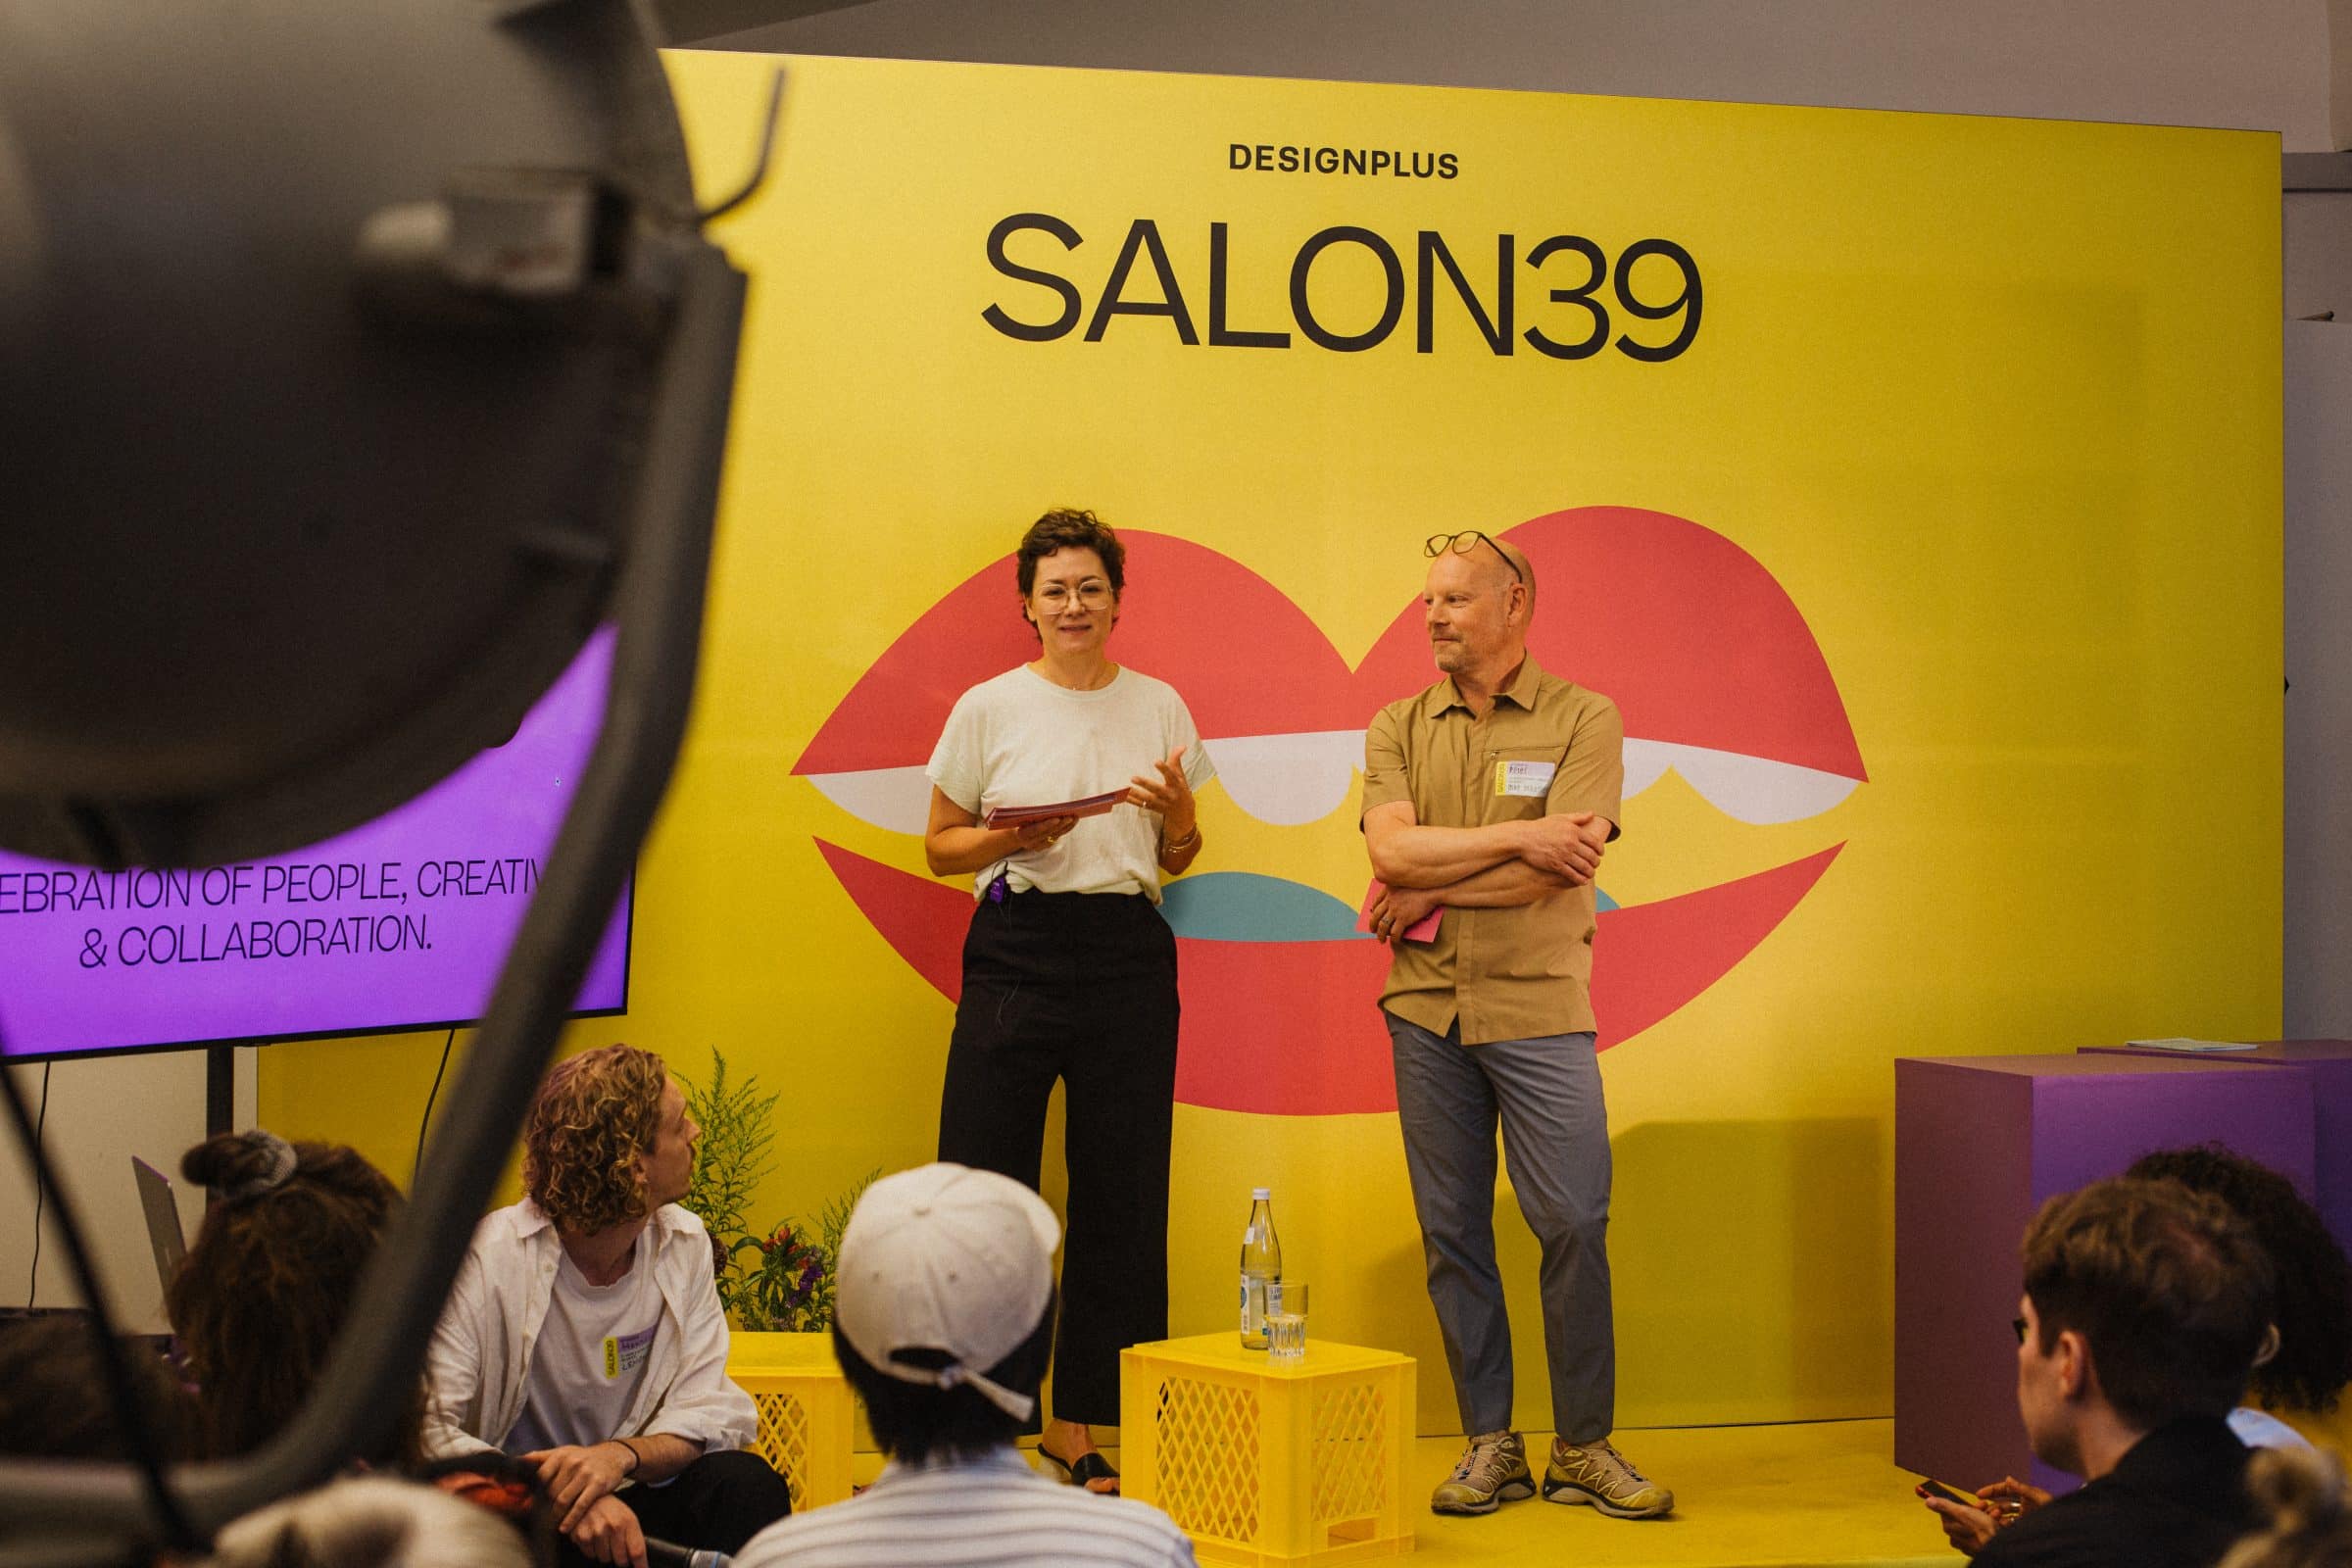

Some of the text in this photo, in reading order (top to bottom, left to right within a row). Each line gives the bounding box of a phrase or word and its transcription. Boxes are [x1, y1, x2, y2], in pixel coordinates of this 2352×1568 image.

[1228, 142, 1459, 180] DESIGNPLUS
[981, 212, 1704, 364] SALON39
[201, 864, 254, 906] OF
[263, 861, 408, 906] PEOPLE,
[78, 912, 433, 969] & COLLABORATION.
